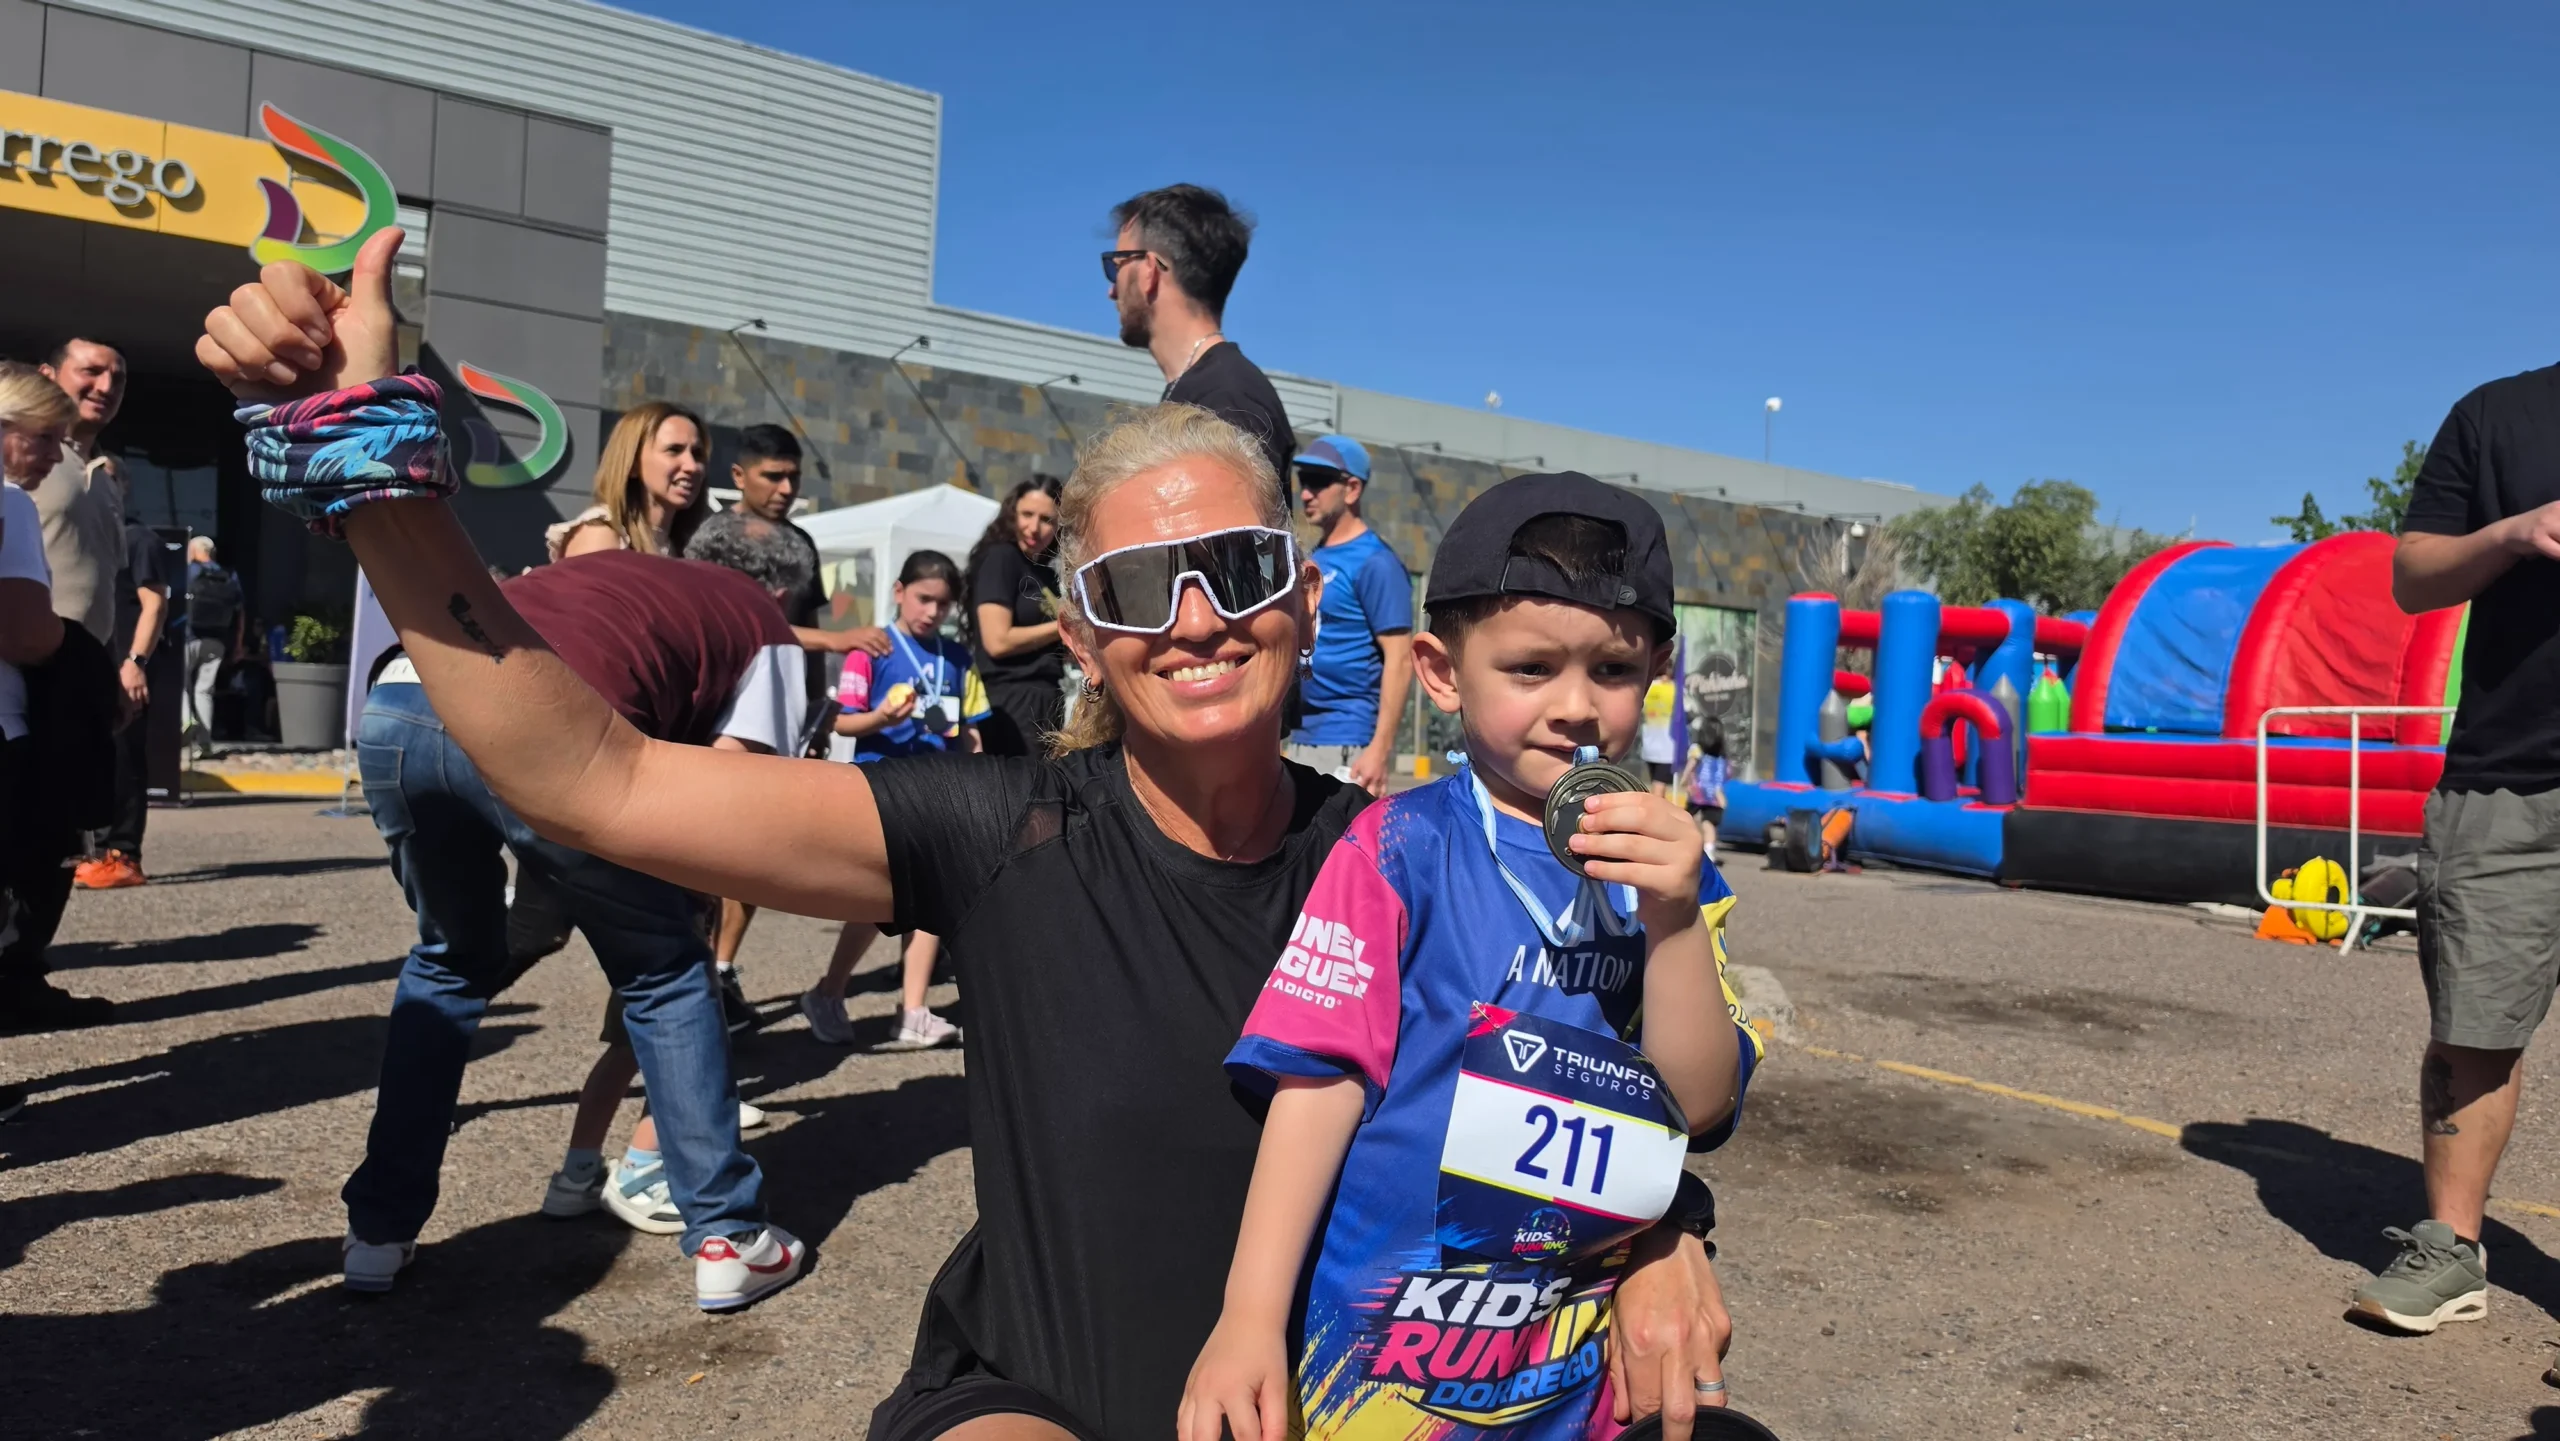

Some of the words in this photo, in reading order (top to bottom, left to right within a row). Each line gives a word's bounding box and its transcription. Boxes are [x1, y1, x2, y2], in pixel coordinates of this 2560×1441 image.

[1531, 947, 1633, 994] NATION
[1553, 1046, 1657, 1090] TRIUNFO
[1553, 1063, 1651, 1100] SEGUROS
[1514, 1104, 1614, 1196] 211
[1511, 1240, 1569, 1254] RUNNING
[1514, 1231, 1554, 1243] KIDS
[1393, 1276, 1572, 1328] KIDS
[1429, 1341, 1599, 1408] DORREGO
